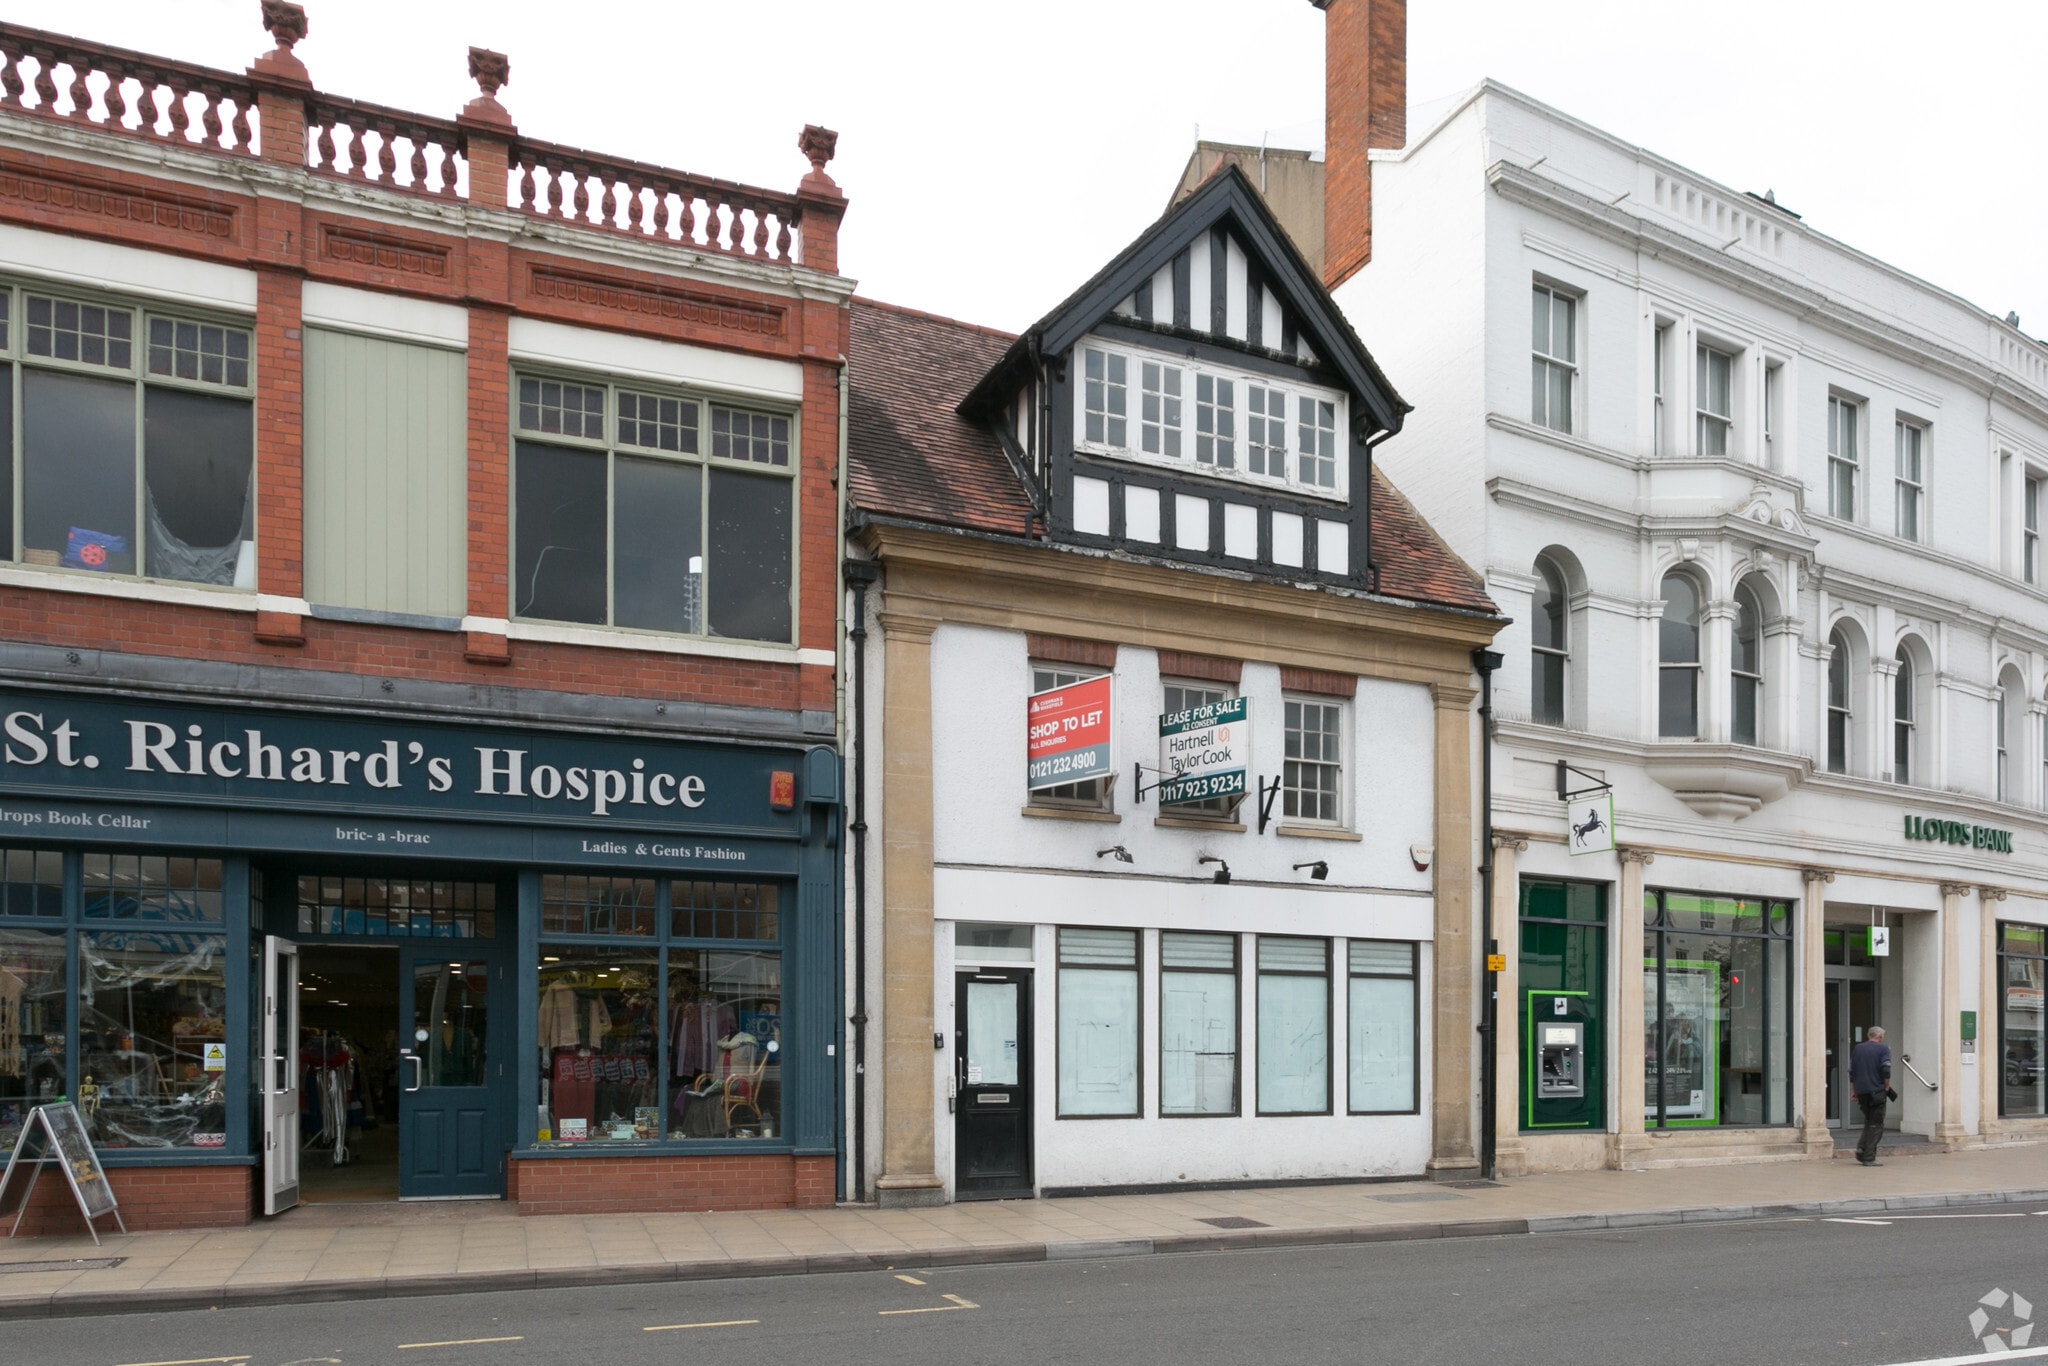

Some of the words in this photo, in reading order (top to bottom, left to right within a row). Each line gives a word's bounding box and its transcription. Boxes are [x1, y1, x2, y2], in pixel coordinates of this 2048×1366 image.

[1030, 720, 1060, 740] SHOP
[1062, 716, 1079, 732] TO
[1081, 710, 1104, 728] LET
[1162, 710, 1192, 727] LEASE
[1193, 705, 1214, 721] FOR
[1216, 699, 1242, 715] SALE
[1190, 717, 1218, 730] CONSENT
[1030, 742, 1040, 750] ALL
[1040, 735, 1067, 748] ENQUIRIES
[1169, 730, 1214, 753] Hartnell
[4, 711, 100, 769] St.
[123, 720, 454, 792] Richard’s
[474, 747, 706, 816] Hospice
[1030, 759, 1052, 779] 0121
[1053, 756, 1071, 774] 232
[1071, 751, 1096, 769] 4900
[1169, 753, 1202, 774] Taylor
[1203, 746, 1232, 765] Cook
[1160, 783, 1185, 803] 0117
[1185, 779, 1208, 797] 923
[1211, 773, 1243, 793] 9234
[48, 810, 93, 826] Book
[98, 813, 151, 829] Cellar
[377, 831, 386, 842] a
[1904, 815, 1972, 846] LLOYDS
[1972, 825, 2015, 854] BANK
[582, 840, 628, 855] Ladies
[635, 843, 648, 855] &
[651, 843, 691, 858] Gents
[694, 846, 746, 861] Fashion
